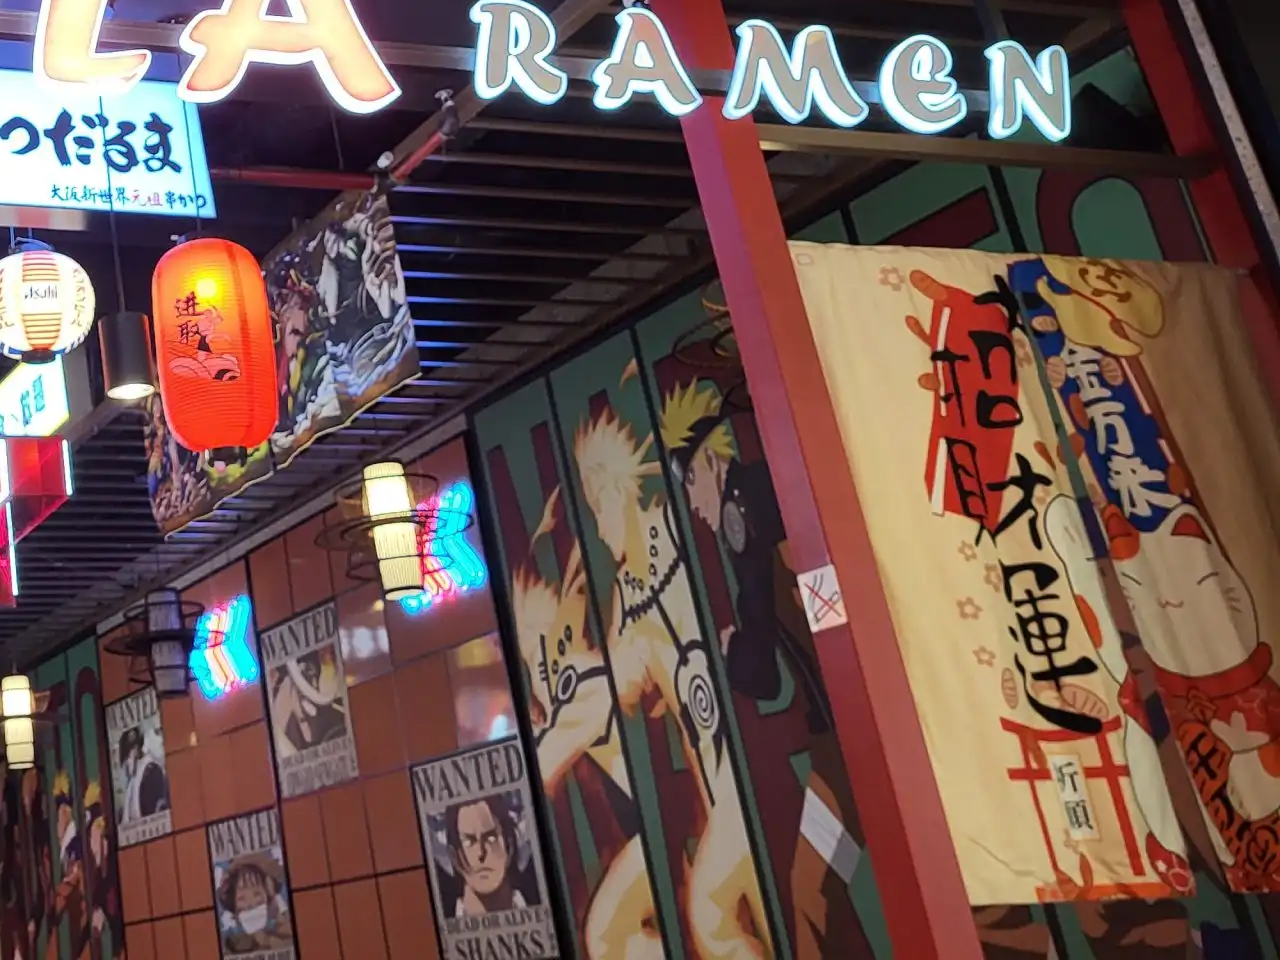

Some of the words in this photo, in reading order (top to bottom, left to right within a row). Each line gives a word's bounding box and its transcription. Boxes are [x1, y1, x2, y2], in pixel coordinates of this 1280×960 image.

[261, 606, 337, 661] WANTED
[413, 744, 524, 803] WANTED
[455, 930, 546, 960] SHANKS
